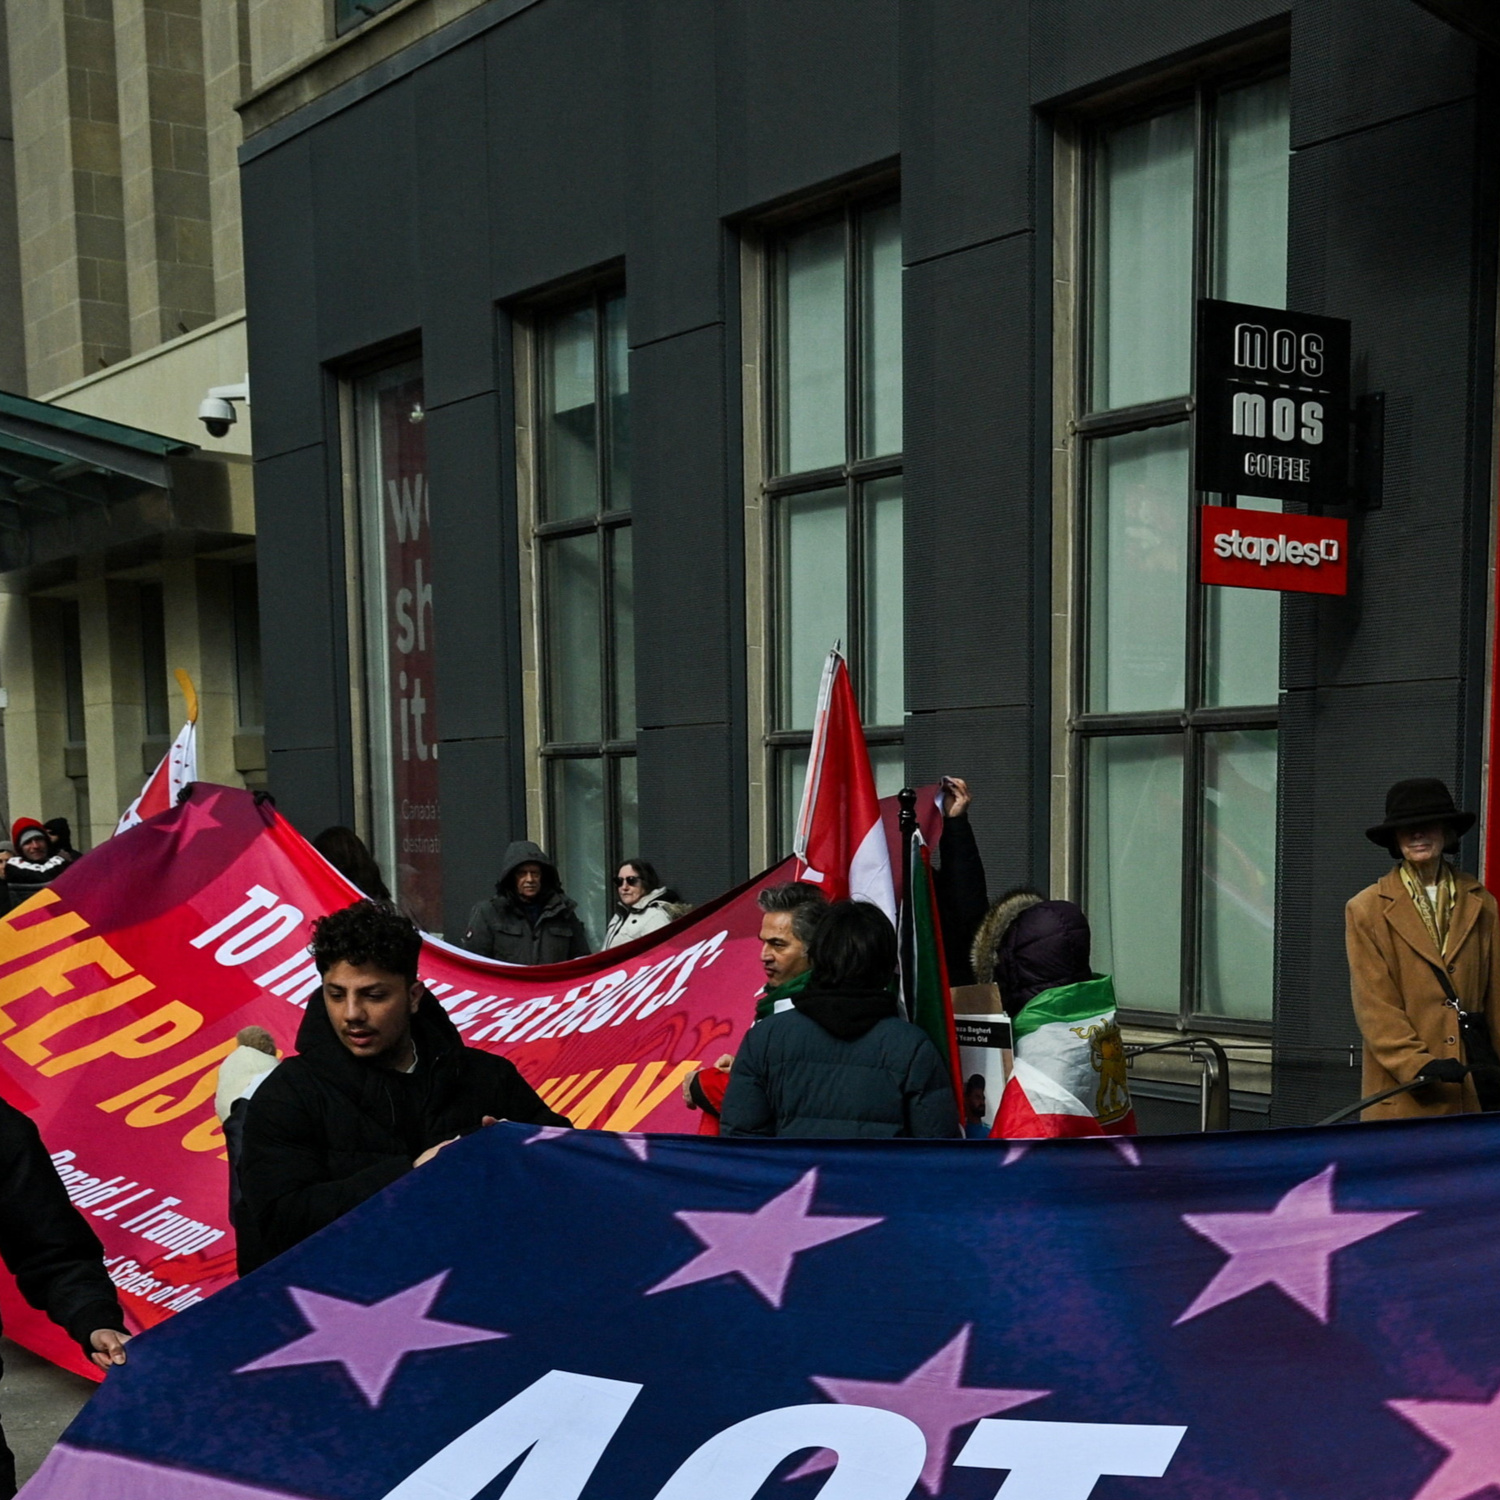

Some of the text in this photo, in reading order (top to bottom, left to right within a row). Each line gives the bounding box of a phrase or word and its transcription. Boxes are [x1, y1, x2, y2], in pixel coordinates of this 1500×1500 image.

[1244, 451, 1311, 483] COFFEE
[1213, 529, 1321, 566] staples
[189, 884, 304, 967] TO
[959, 1034, 976, 1042] Years
[976, 1035, 988, 1043] Old
[119, 1196, 226, 1261] Trump
[107, 1259, 162, 1297] States
[146, 1282, 190, 1305] of
